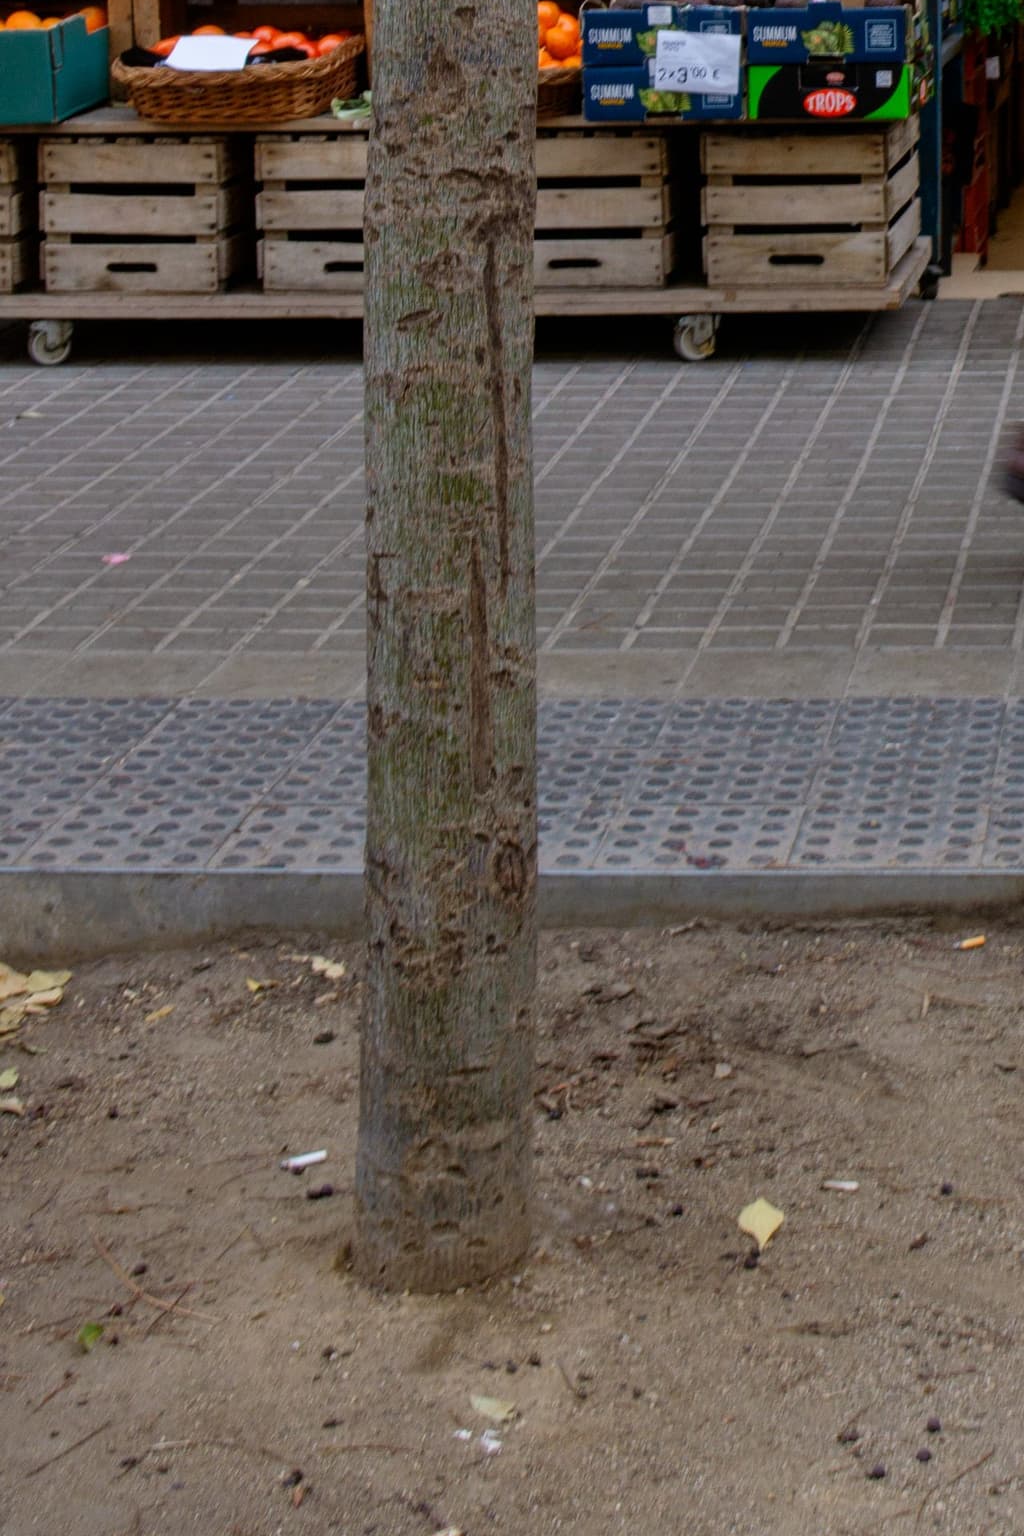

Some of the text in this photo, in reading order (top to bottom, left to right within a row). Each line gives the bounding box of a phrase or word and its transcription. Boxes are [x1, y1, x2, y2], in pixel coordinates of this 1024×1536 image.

[588, 27, 633, 45] SUMMUM
[752, 24, 798, 43] SUMMUM
[590, 83, 635, 102] SUMMUM
[805, 90, 854, 113] TROPS
